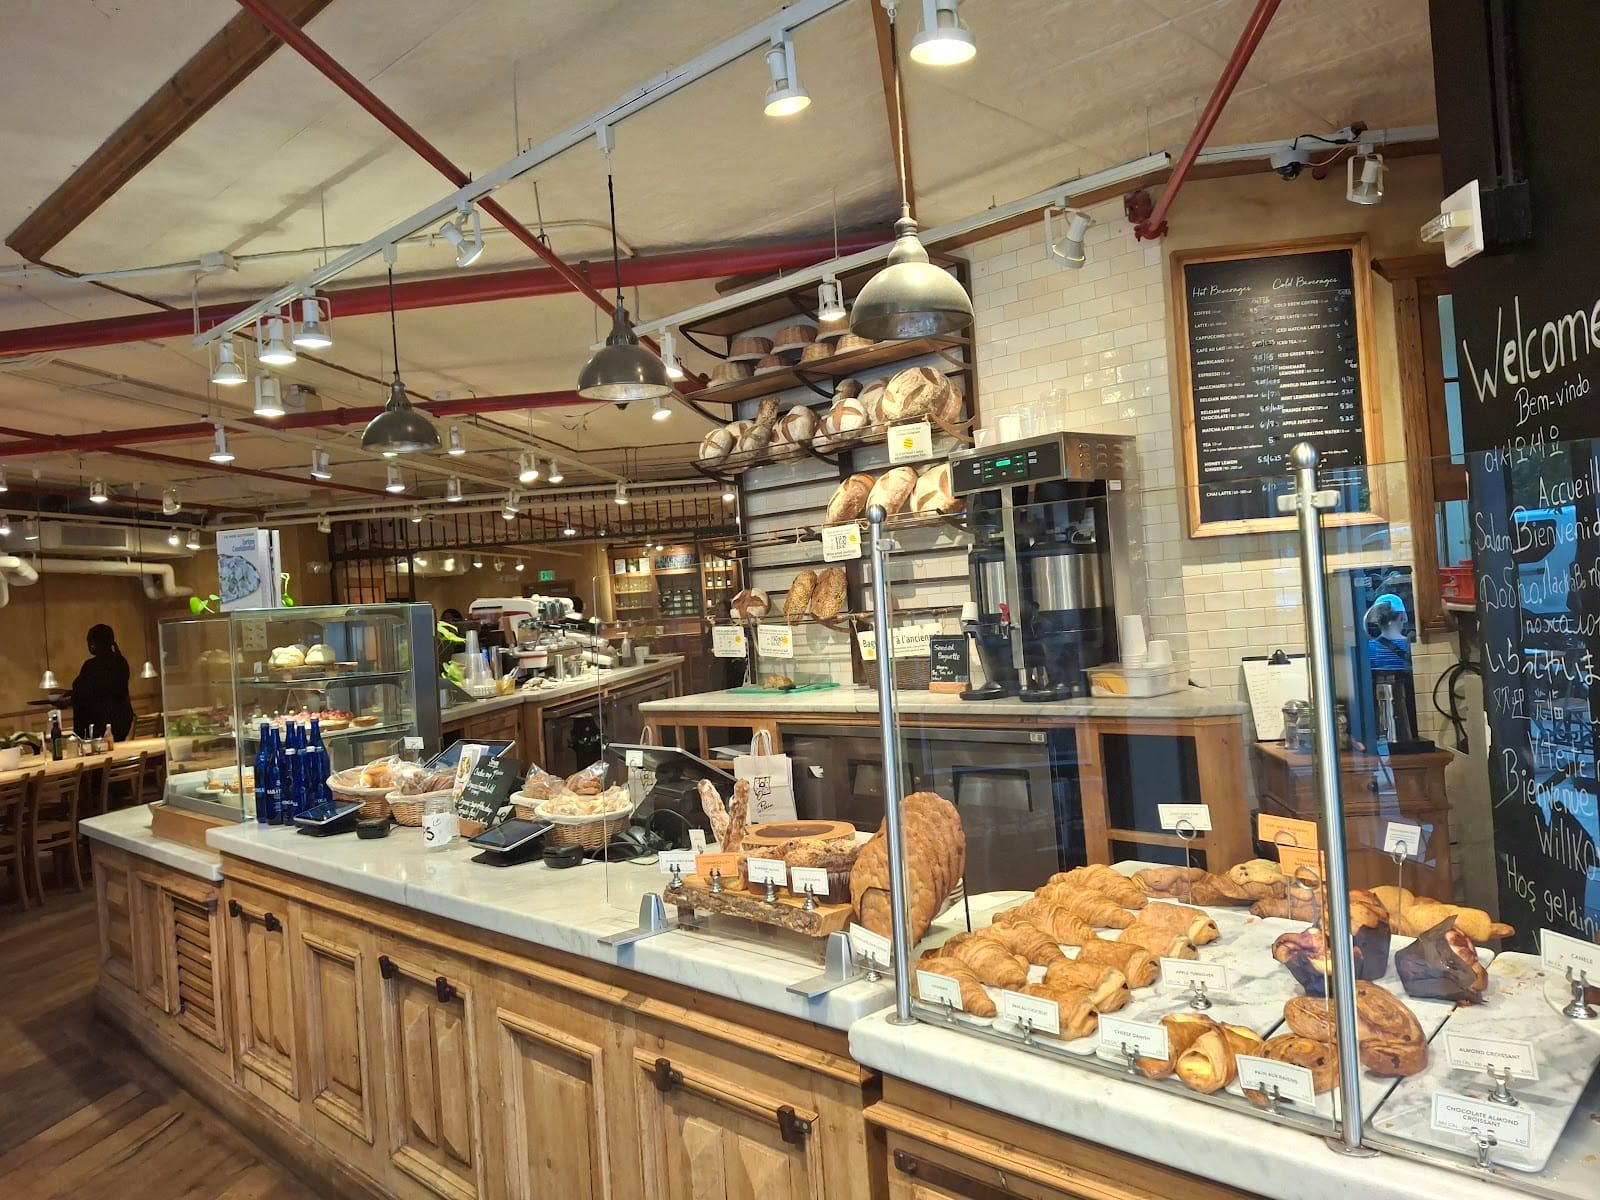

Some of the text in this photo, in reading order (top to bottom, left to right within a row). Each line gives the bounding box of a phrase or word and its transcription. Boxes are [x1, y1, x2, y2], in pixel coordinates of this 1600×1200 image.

[1192, 284, 1252, 298] Hot Beverages
[1272, 275, 1338, 290] Cold Beverages
[1462, 296, 1600, 403] Welcome
[1514, 373, 1591, 427] Bem-vindo
[1484, 425, 1564, 473] 어서오세요
[1475, 511, 1513, 554] Salam
[1495, 747, 1594, 817] Bienvenue
[1505, 853, 1537, 913] Hoş
[1459, 1046, 1520, 1060] ALMOND CROISSANT
[1446, 1105, 1519, 1126] CHOCOLATE ALMOND
[1462, 1114, 1501, 1128] CROISSANT
